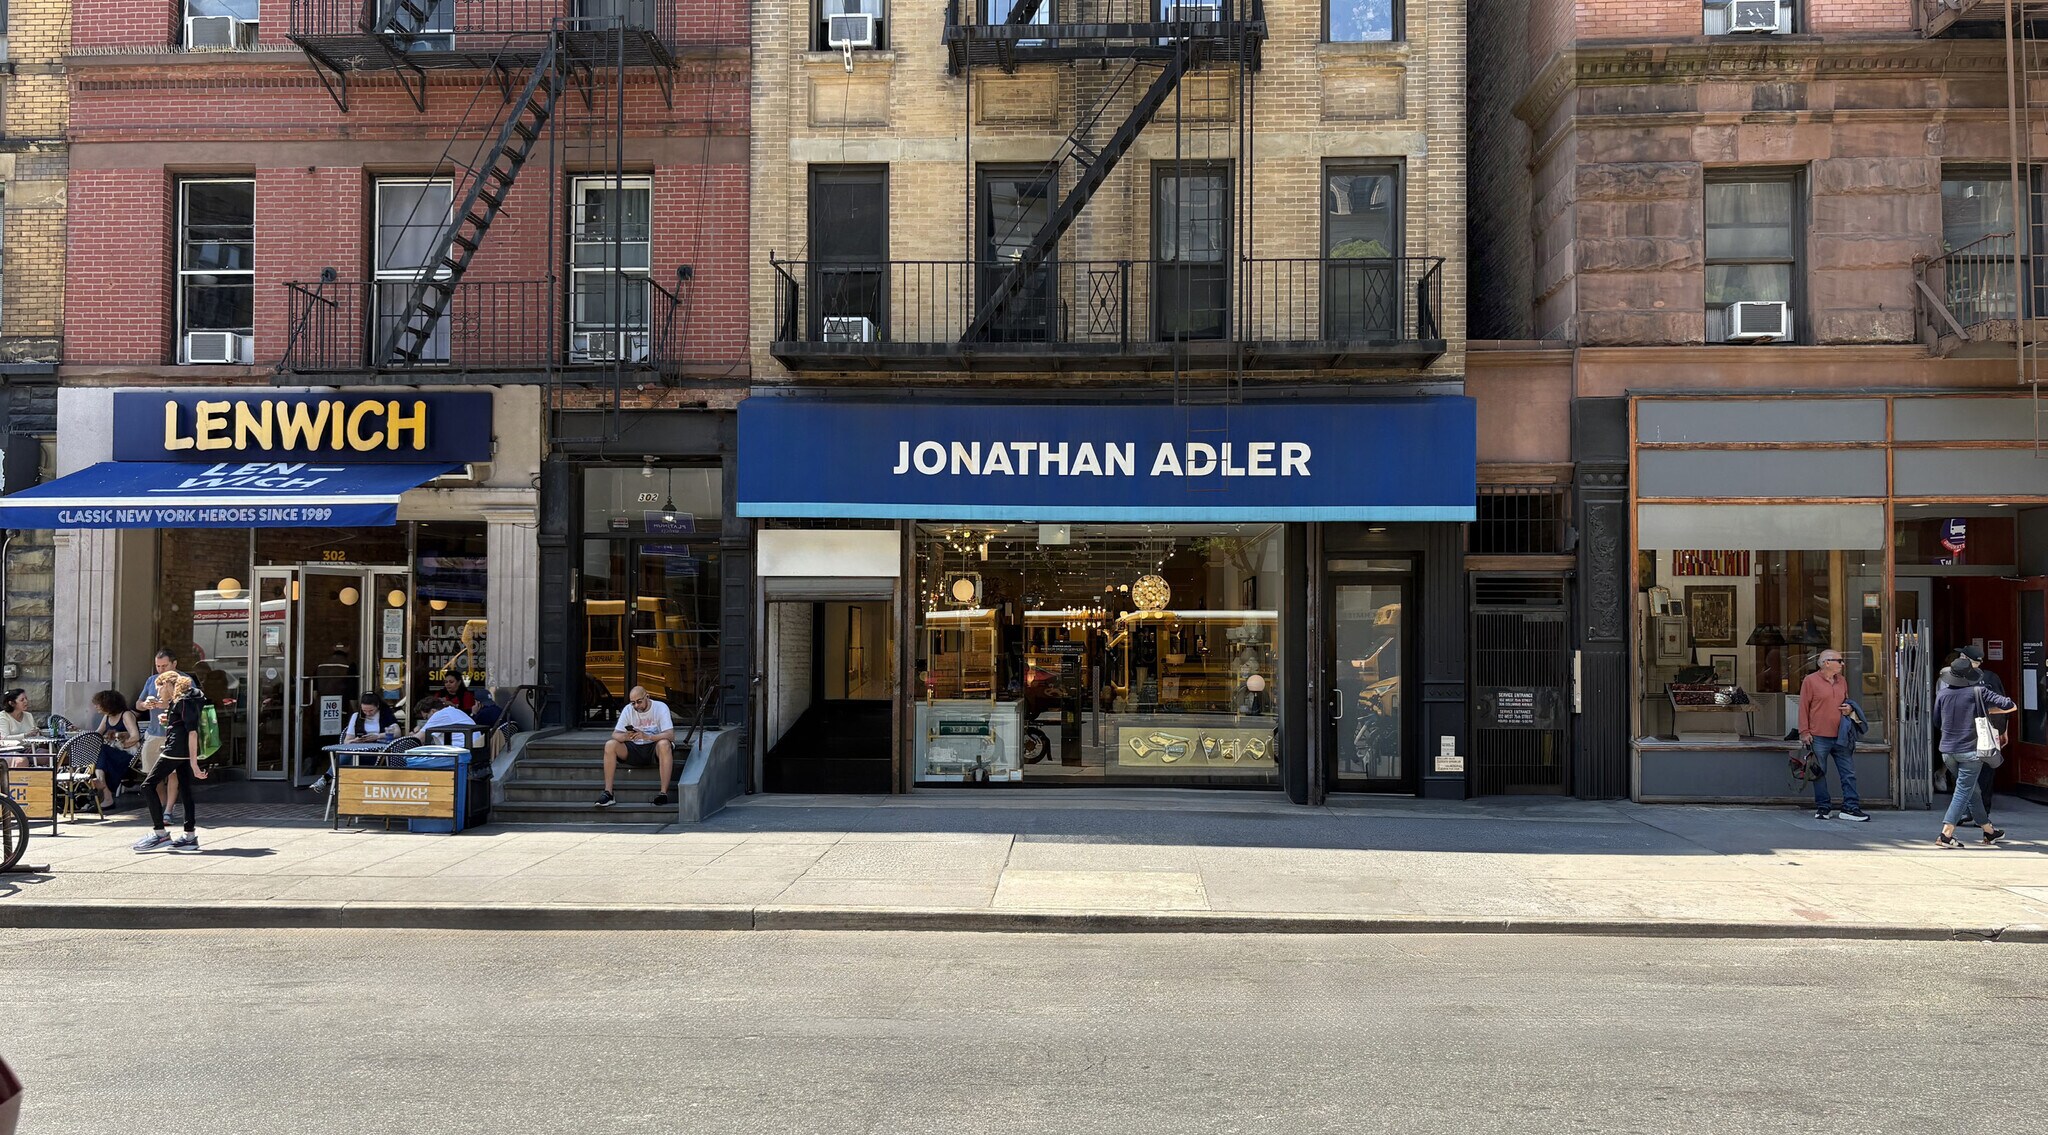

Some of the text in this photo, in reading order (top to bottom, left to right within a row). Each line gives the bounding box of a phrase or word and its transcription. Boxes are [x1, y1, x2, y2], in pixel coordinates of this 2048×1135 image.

[164, 400, 427, 451] LENWICH
[894, 441, 1312, 476] JONATHAN ADLER
[177, 476, 328, 488] WICH
[58, 507, 332, 523] CLASSIC NEW YORK HEROES SINCE 1989
[323, 551, 346, 561] 302
[417, 641, 487, 653] NEW YOR
[385, 665, 398, 678] A
[326, 702, 338, 710] NO
[364, 786, 428, 799] LENWICH
